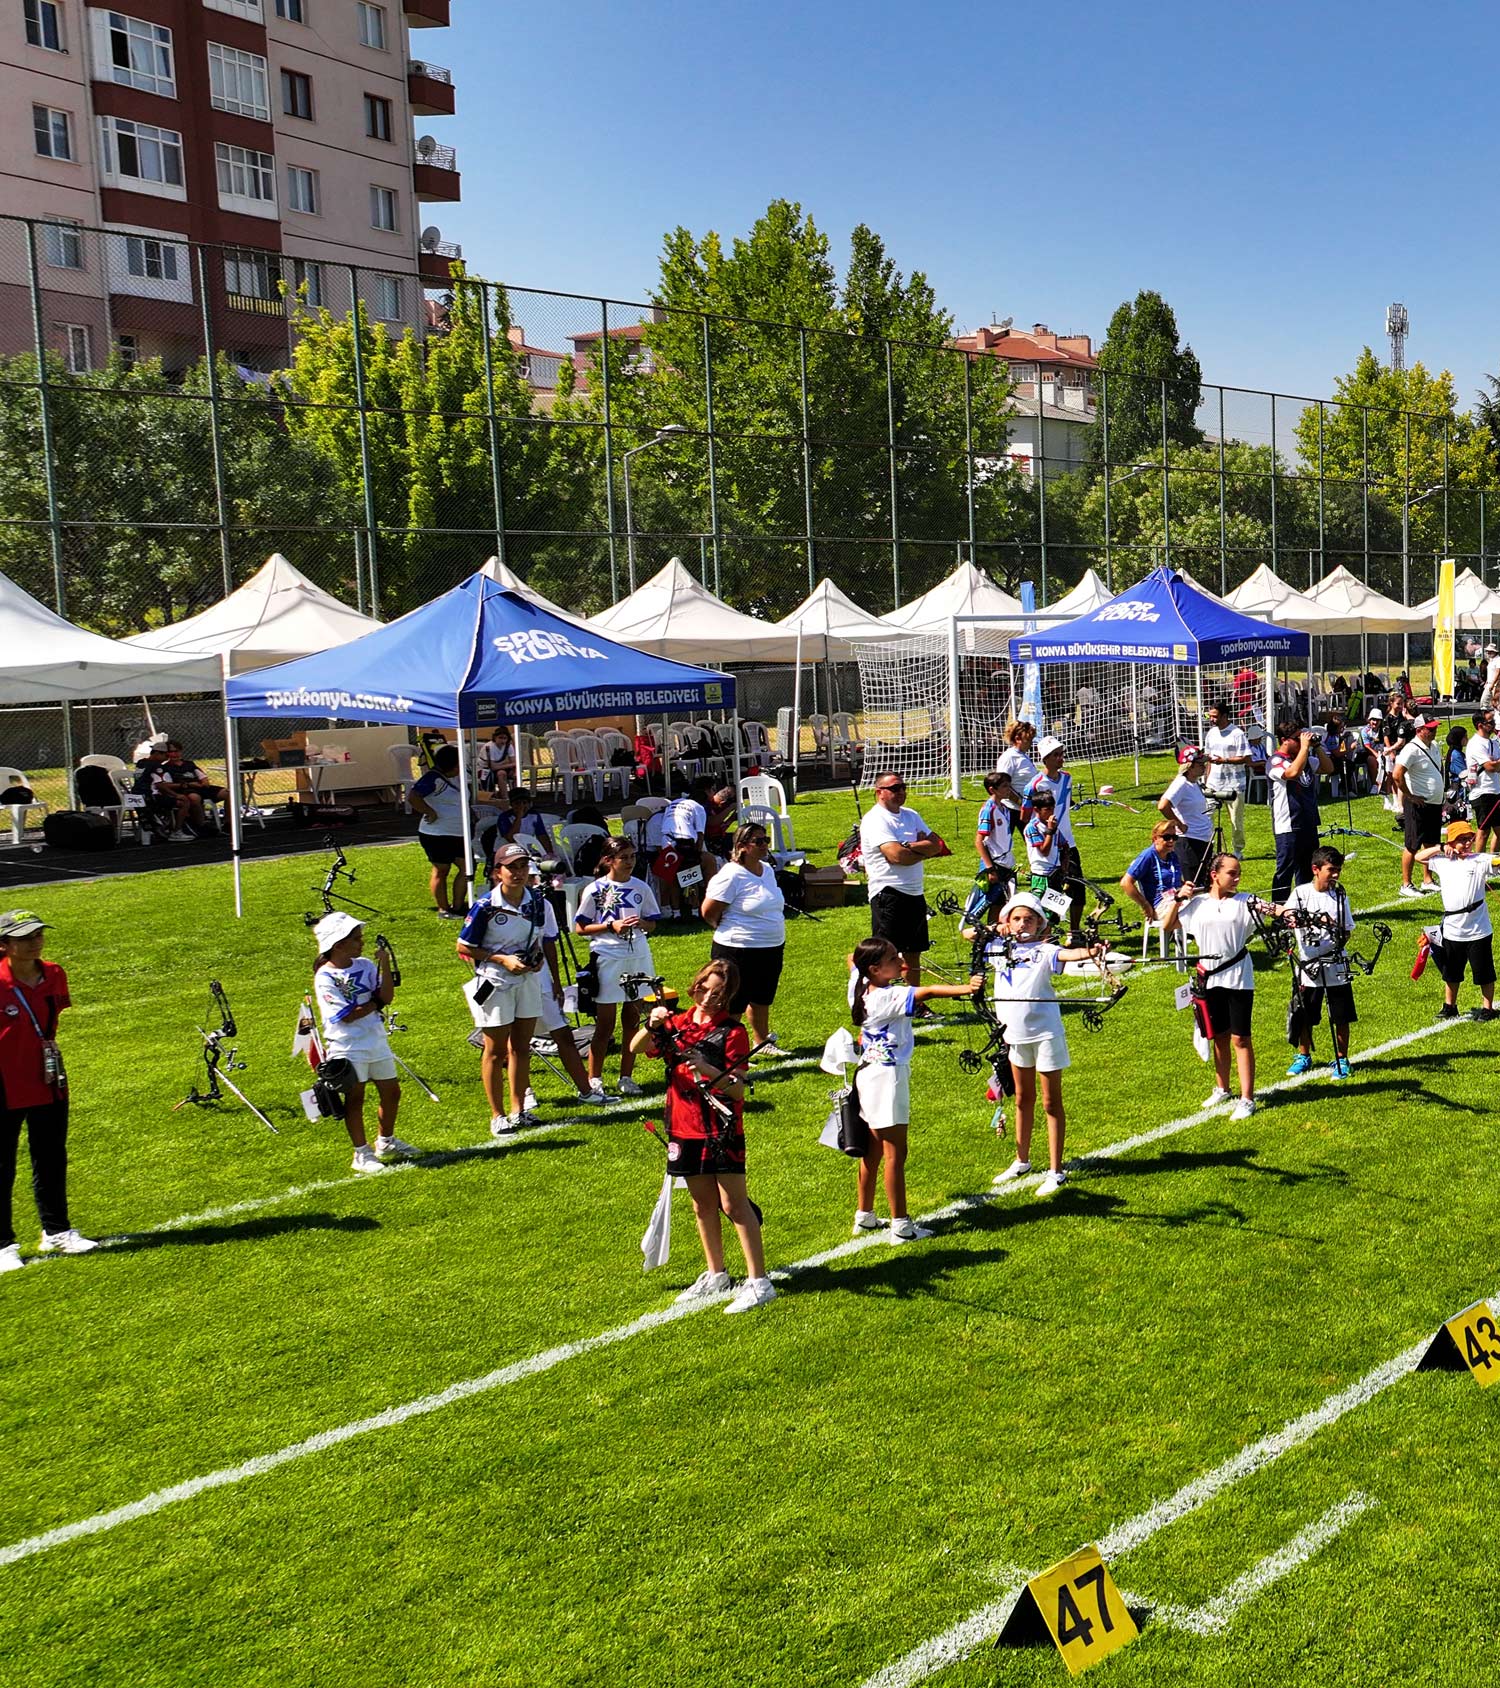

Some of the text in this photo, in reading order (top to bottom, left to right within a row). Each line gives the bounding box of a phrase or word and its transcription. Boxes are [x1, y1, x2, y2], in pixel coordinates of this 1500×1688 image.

[1091, 608, 1161, 622] KONYA
[1103, 601, 1155, 613] SPOR
[493, 629, 573, 651] SPOR
[1035, 646, 1067, 657] KONYA
[1068, 642, 1121, 656] BÜYÜKŞEHİR
[1122, 643, 1170, 657] BELEDİYESİ
[1220, 638, 1291, 656] sporkonya.com.tr
[508, 640, 609, 664] KONYA
[265, 687, 414, 712] sporkonya.com.tr
[504, 699, 551, 716] KONYA
[556, 691, 634, 711] BÜYÜKŞEHİR
[635, 688, 700, 707] BELEDİYESİ
[681, 871, 698, 882] 29C
[1057, 1563, 1116, 1648] 47
